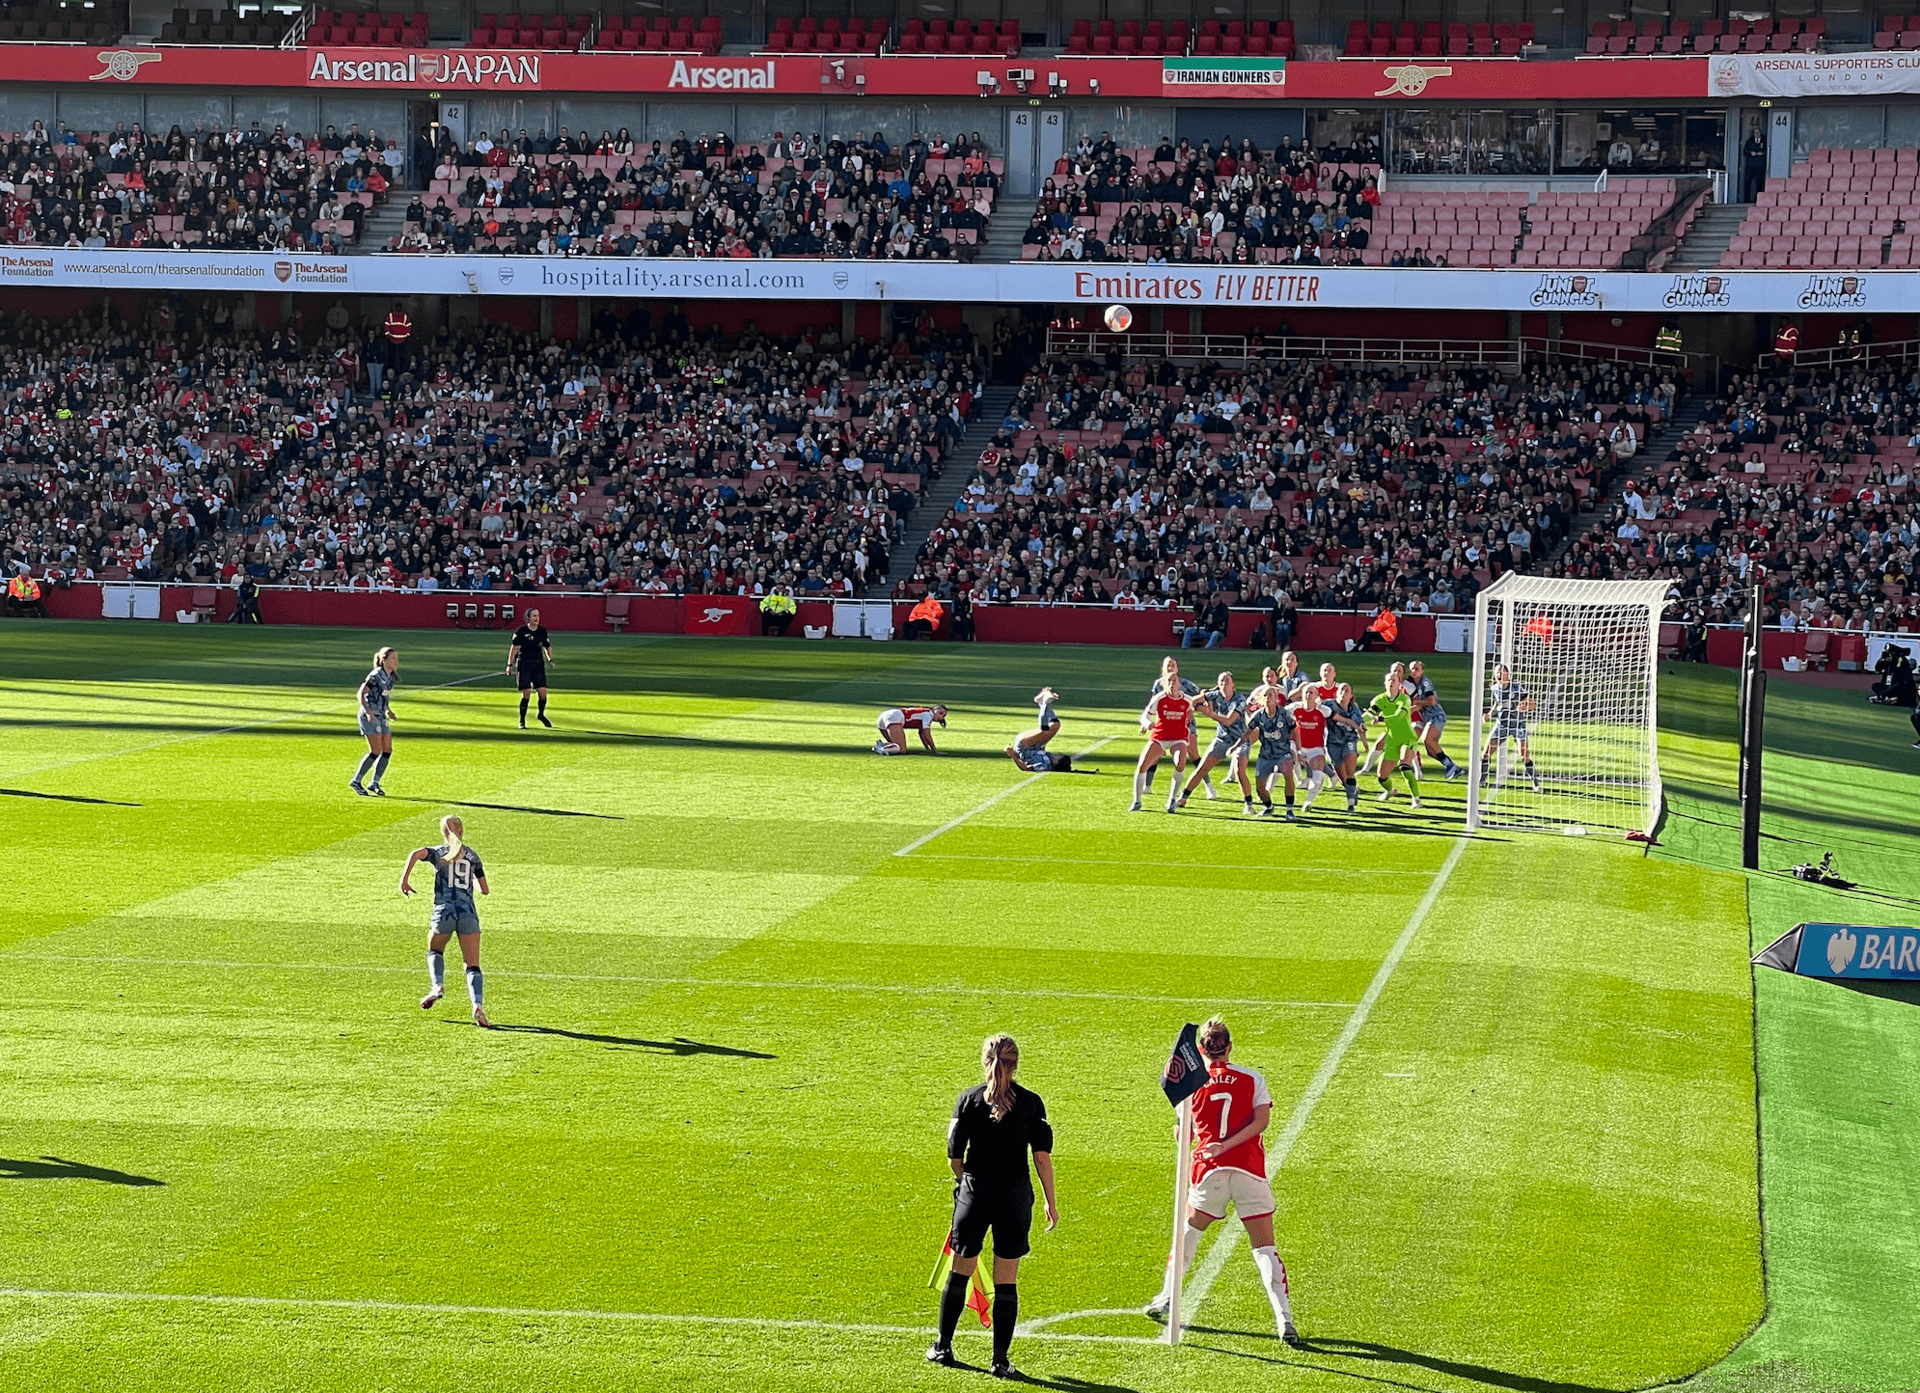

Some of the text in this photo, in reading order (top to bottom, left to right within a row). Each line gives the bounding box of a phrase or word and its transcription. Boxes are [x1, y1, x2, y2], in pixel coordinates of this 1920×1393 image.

[310, 52, 540, 84] Arsenal JAPAN
[1755, 60, 1810, 71] ARSENAL
[1814, 58, 1894, 69] SUPPORTERS
[668, 59, 775, 89] Arsenal
[1177, 71, 1271, 83] IRANIAN GUNNERS
[1799, 73, 1883, 82] LONDON
[447, 107, 459, 118] 42
[1015, 114, 1027, 125] 43
[1046, 114, 1058, 125] 43
[1775, 115, 1787, 126] 44
[0, 256, 54, 267] The Arsenal
[294, 262, 348, 273] The Arsenal
[2, 266, 54, 277] Foundation
[64, 262, 265, 277] www.arsenal.com/thearsenalfoundation
[295, 273, 348, 283] Foundation
[542, 266, 805, 291] hospitality.arsenal.com
[1075, 272, 1320, 301] Emirates FLY BETTER
[447, 859, 471, 890] 19
[1859, 934, 1920, 972] BAR
[1210, 1092, 1232, 1139] 7
